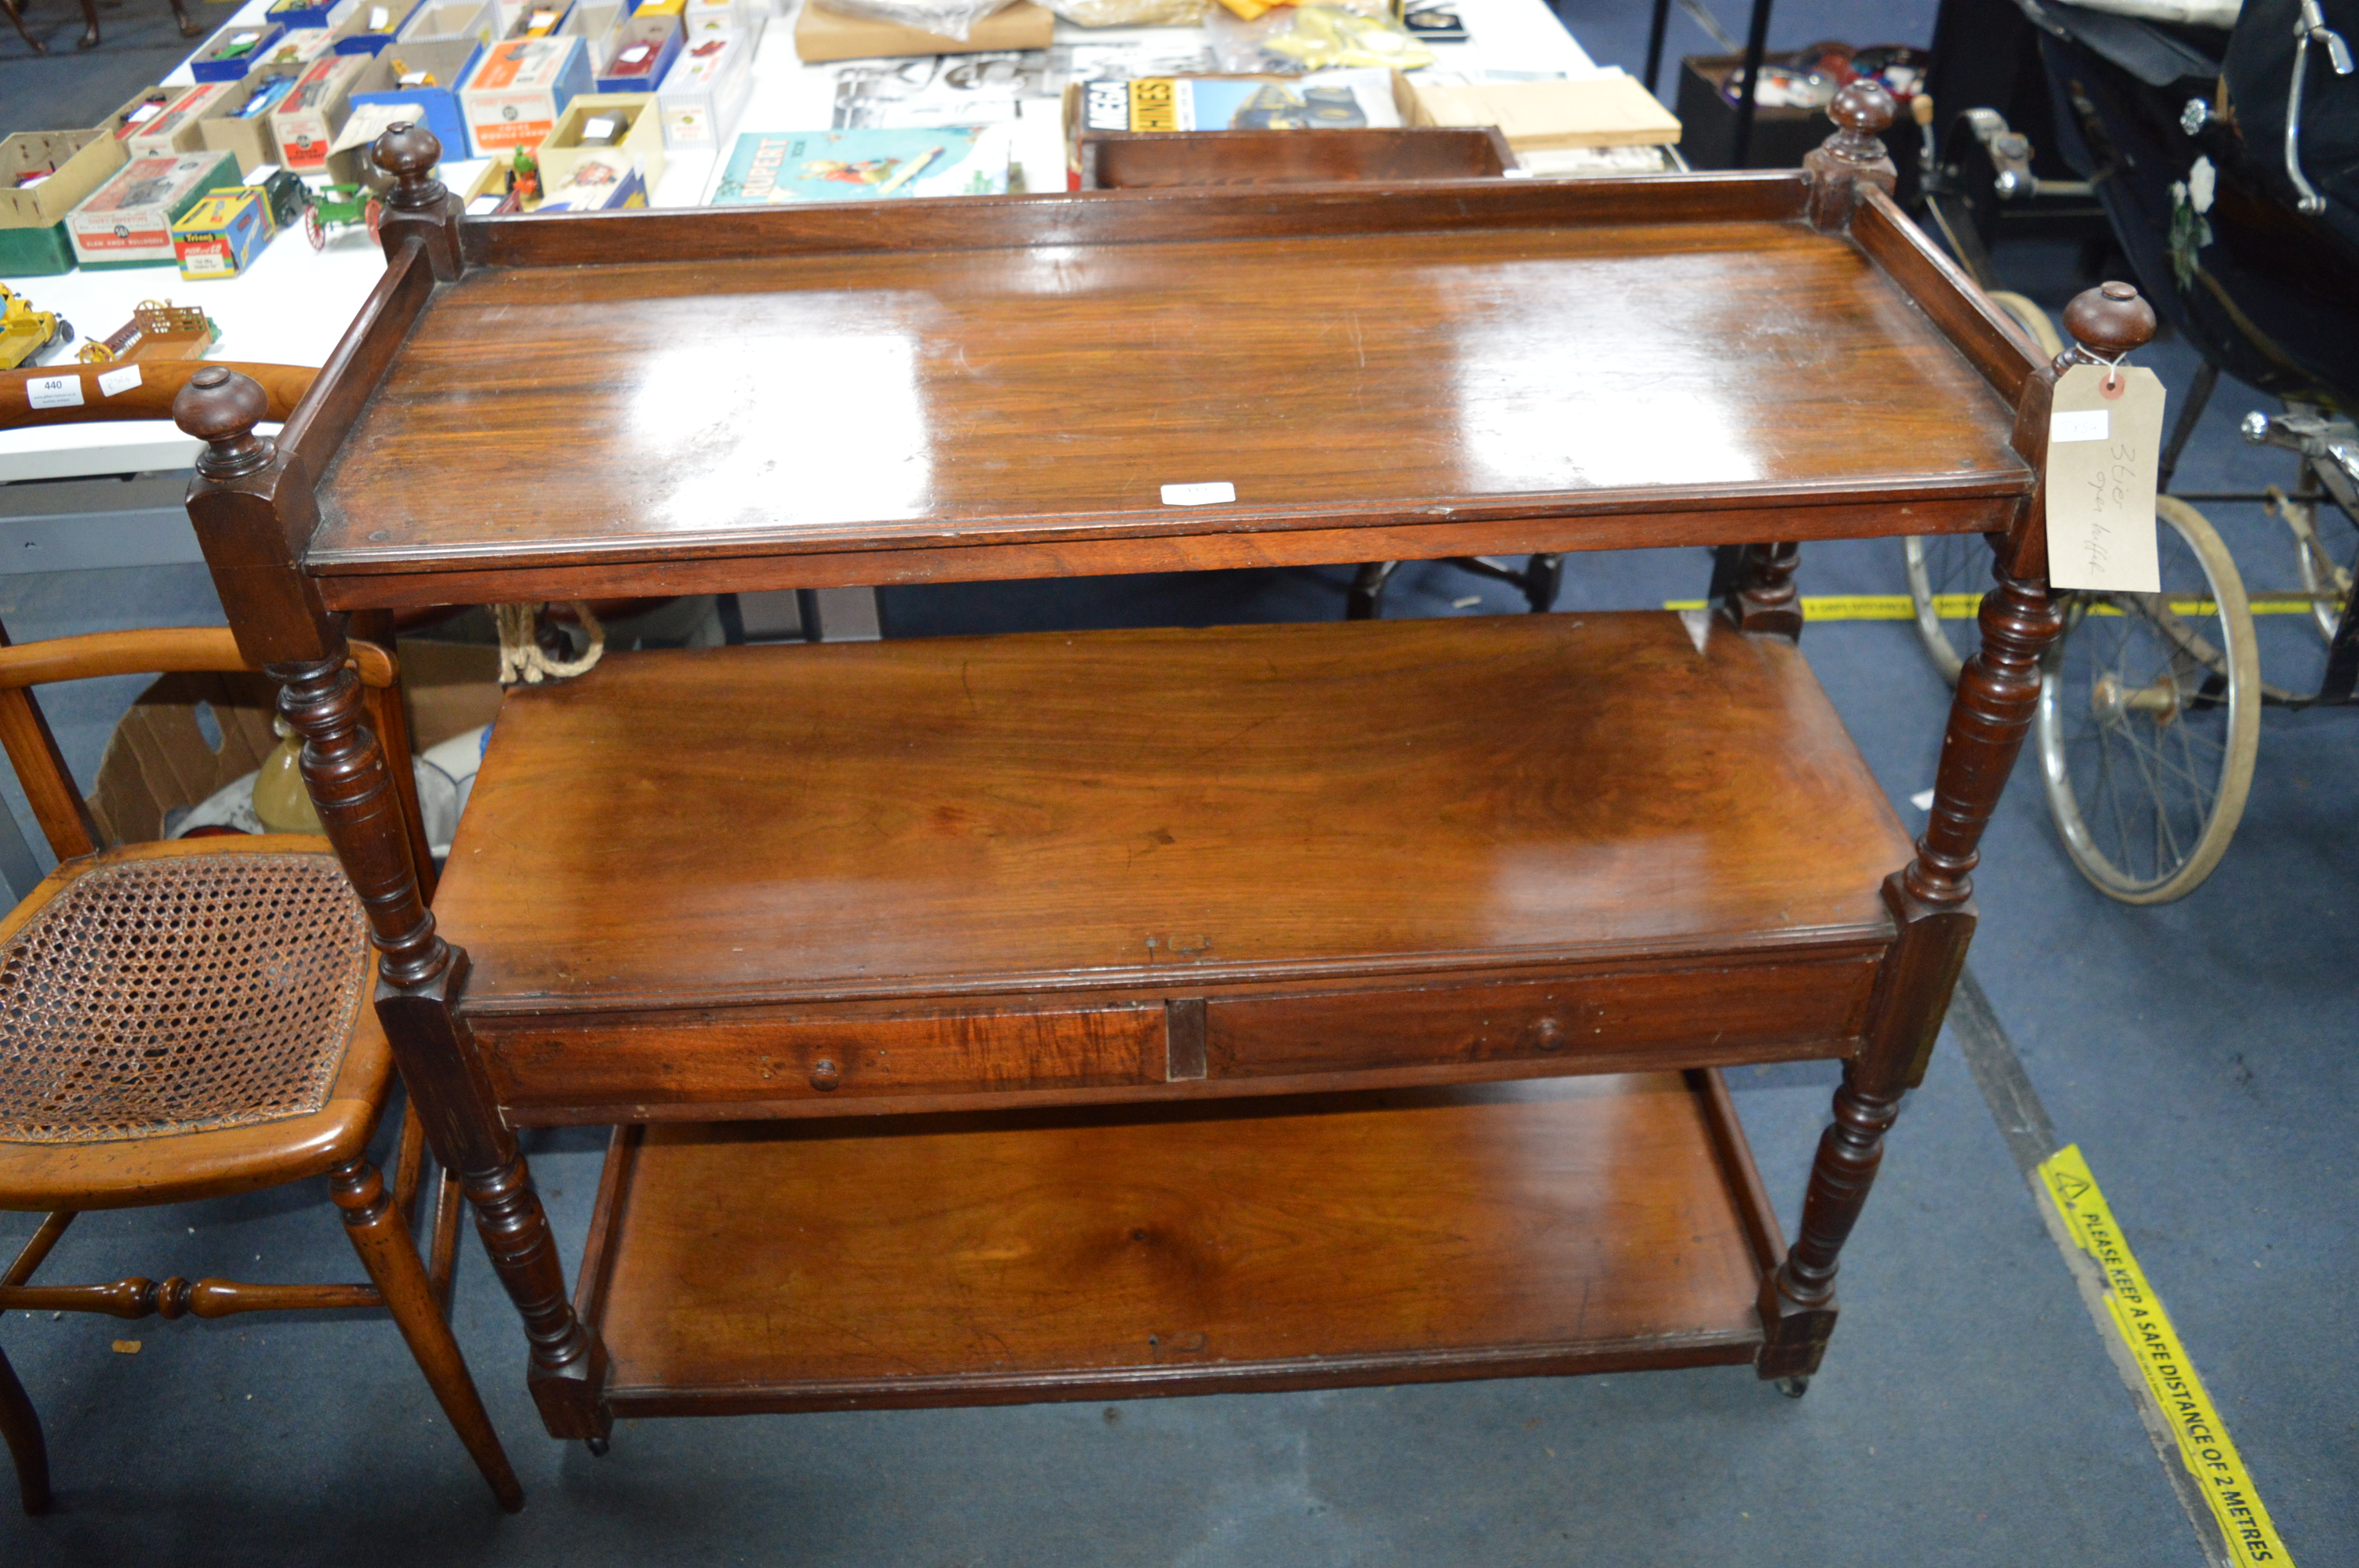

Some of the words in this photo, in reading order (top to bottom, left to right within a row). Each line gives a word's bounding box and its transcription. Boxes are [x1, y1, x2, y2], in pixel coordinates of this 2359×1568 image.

[1089, 81, 1128, 130] MEGA
[1137, 82, 1172, 129] HINES
[740, 137, 789, 198] RUPERT
[44, 380, 63, 390] 440
[2110, 444, 2136, 463] 3
[2111, 465, 2136, 510] tier
[2082, 1213, 2122, 1265] PLEASE
[2110, 1268, 2143, 1304] KEEP
[2129, 1307, 2149, 1319] A
[2138, 1322, 2172, 1361] SAFE
[2157, 1365, 2215, 1445] DISTANCE
[2201, 1448, 2230, 1472] OF
[2214, 1476, 2235, 1487] 2
[2221, 1491, 2274, 1563] METRES
